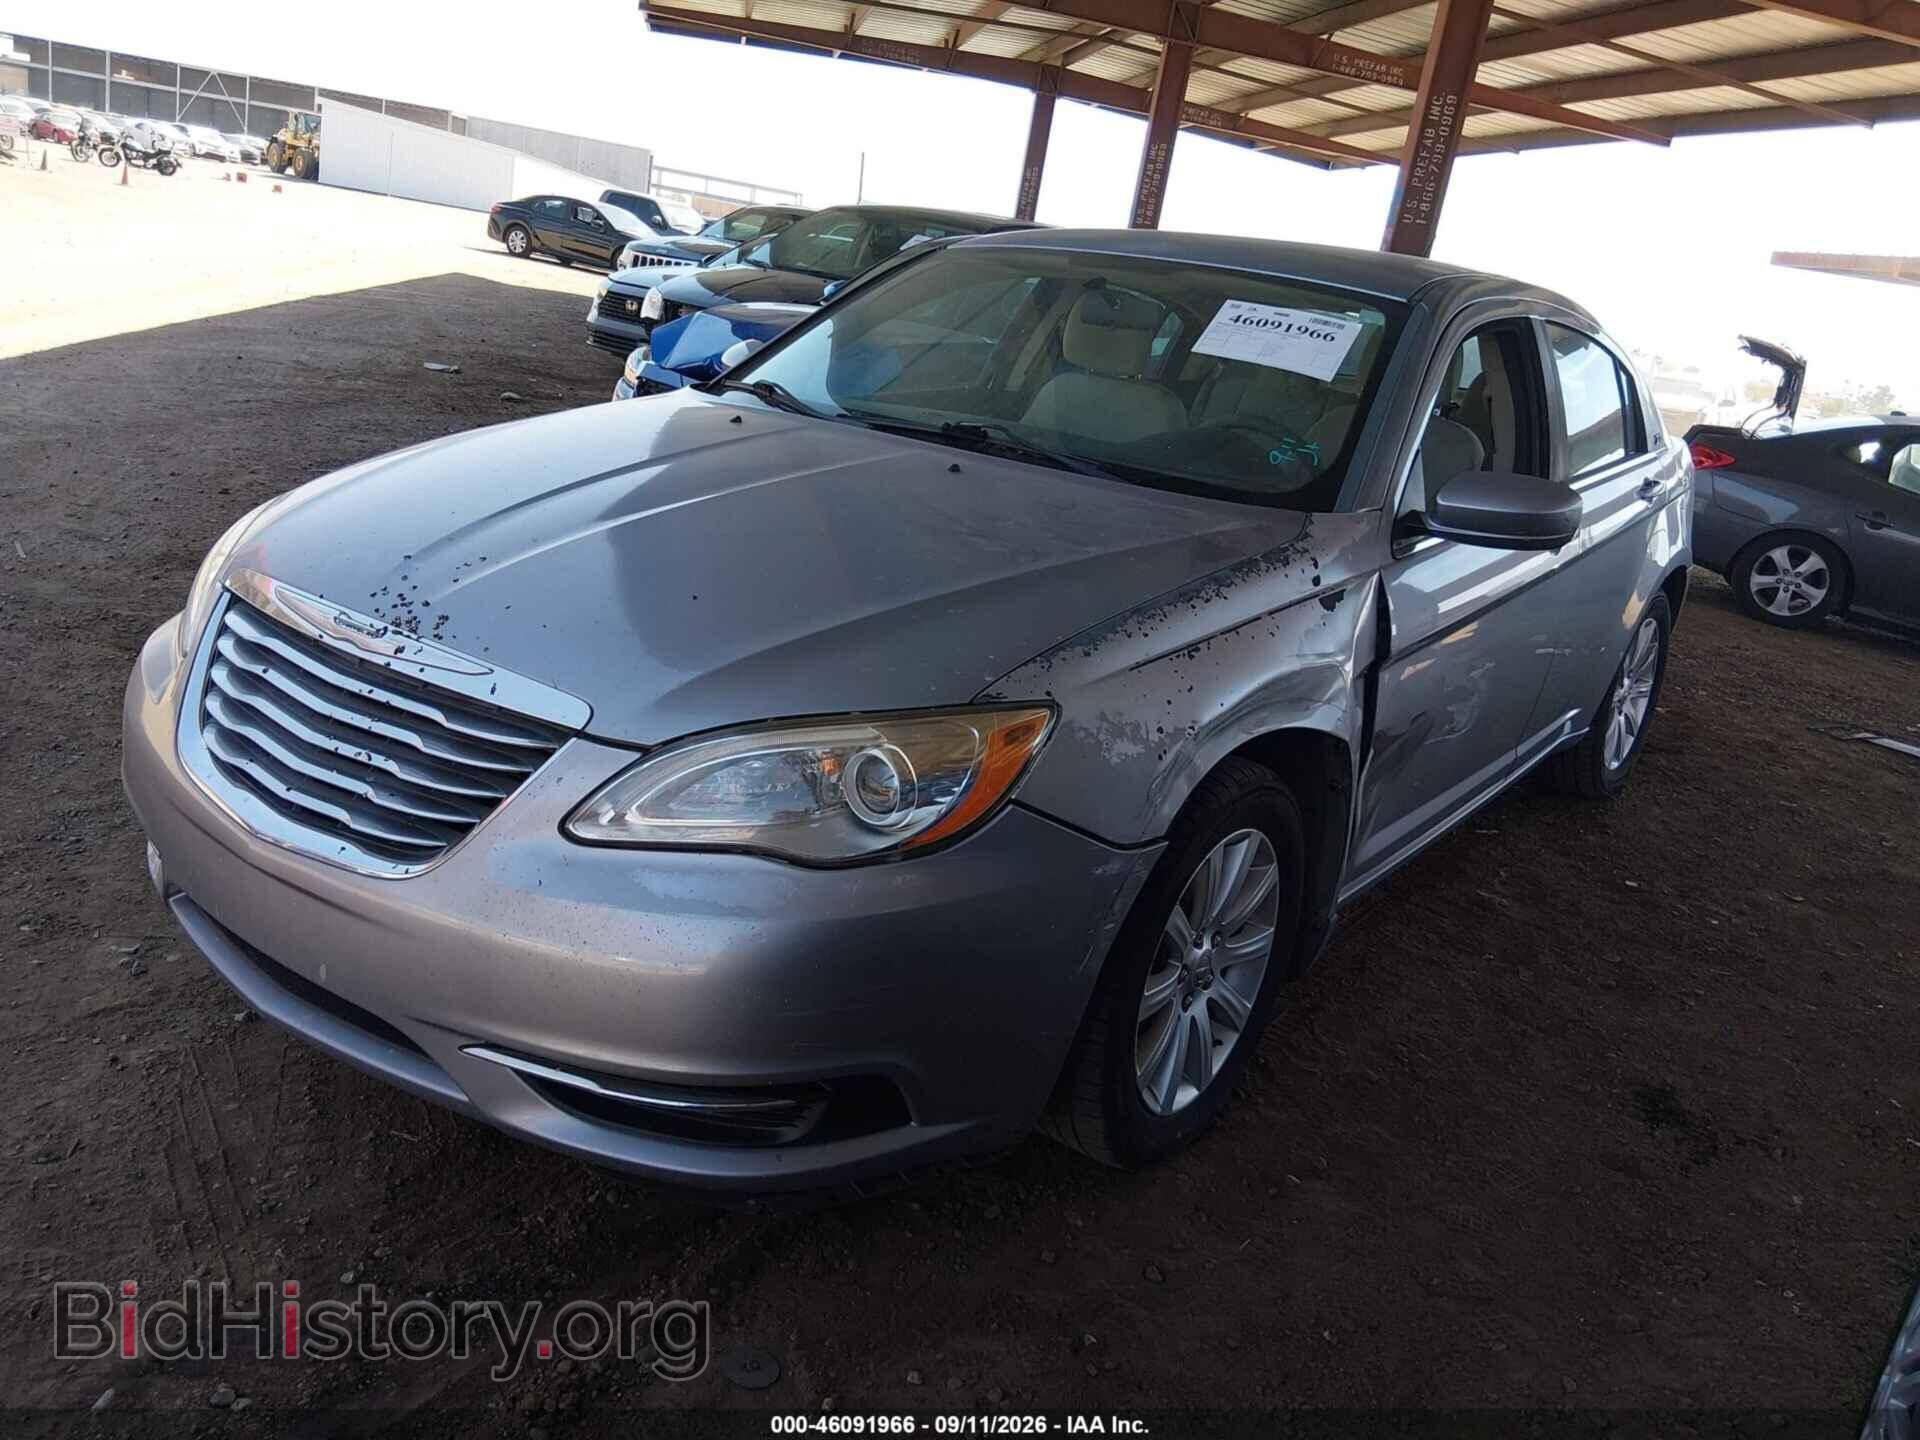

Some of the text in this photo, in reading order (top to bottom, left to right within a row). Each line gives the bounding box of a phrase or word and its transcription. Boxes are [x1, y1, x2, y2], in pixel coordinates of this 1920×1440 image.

[1411, 128, 1436, 187] PREFAB
[1416, 95, 1457, 224] 1-866-799-0969
[1229, 313, 1336, 343] 46091966
